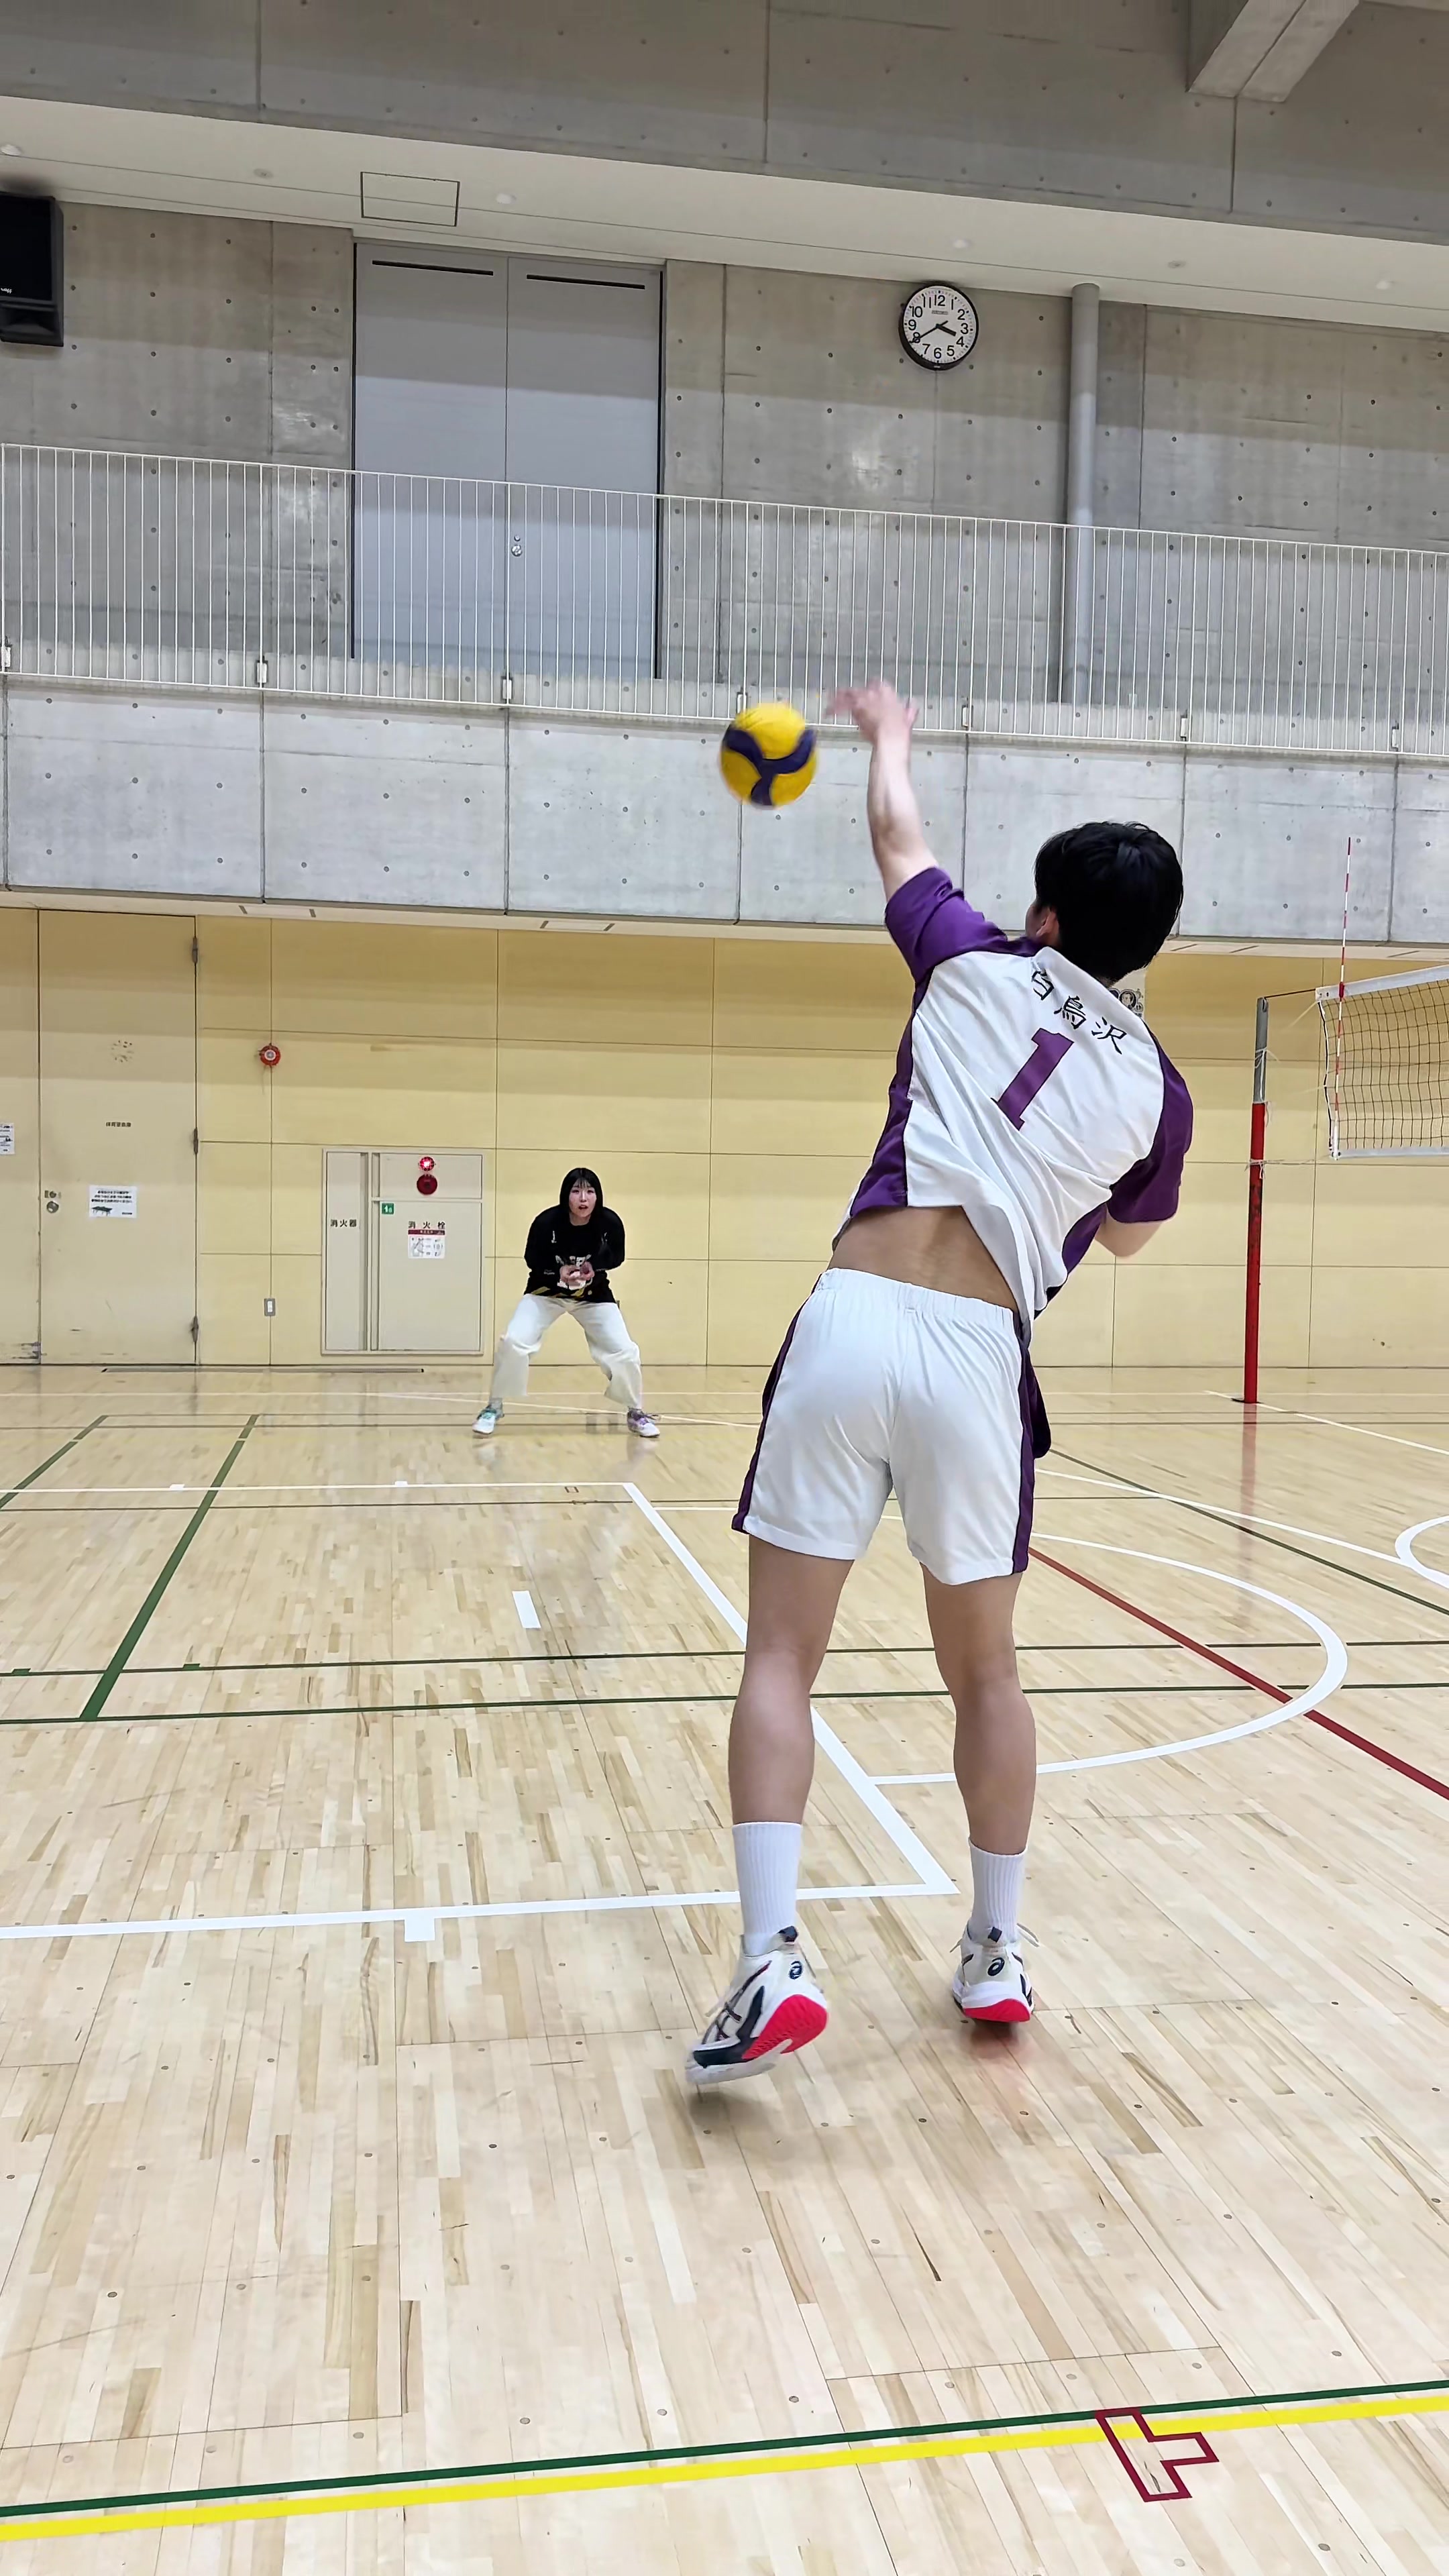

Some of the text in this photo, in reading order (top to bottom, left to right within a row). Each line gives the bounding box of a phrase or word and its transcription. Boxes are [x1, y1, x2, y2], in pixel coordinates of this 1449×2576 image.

[923, 296, 931, 309] 11
[934, 294, 945, 307] 12
[912, 306, 923, 318] 10
[957, 309, 965, 320] 2
[908, 319, 916, 331] 9
[960, 323, 969, 335] 3
[912, 331, 920, 343] 8
[956, 336, 965, 347] 4
[922, 343, 930, 354] 7
[933, 347, 942, 359] 6
[947, 345, 955, 356] 5
[990, 1028, 1075, 1131] 1
[408, 1221, 445, 1230] 消火栓
